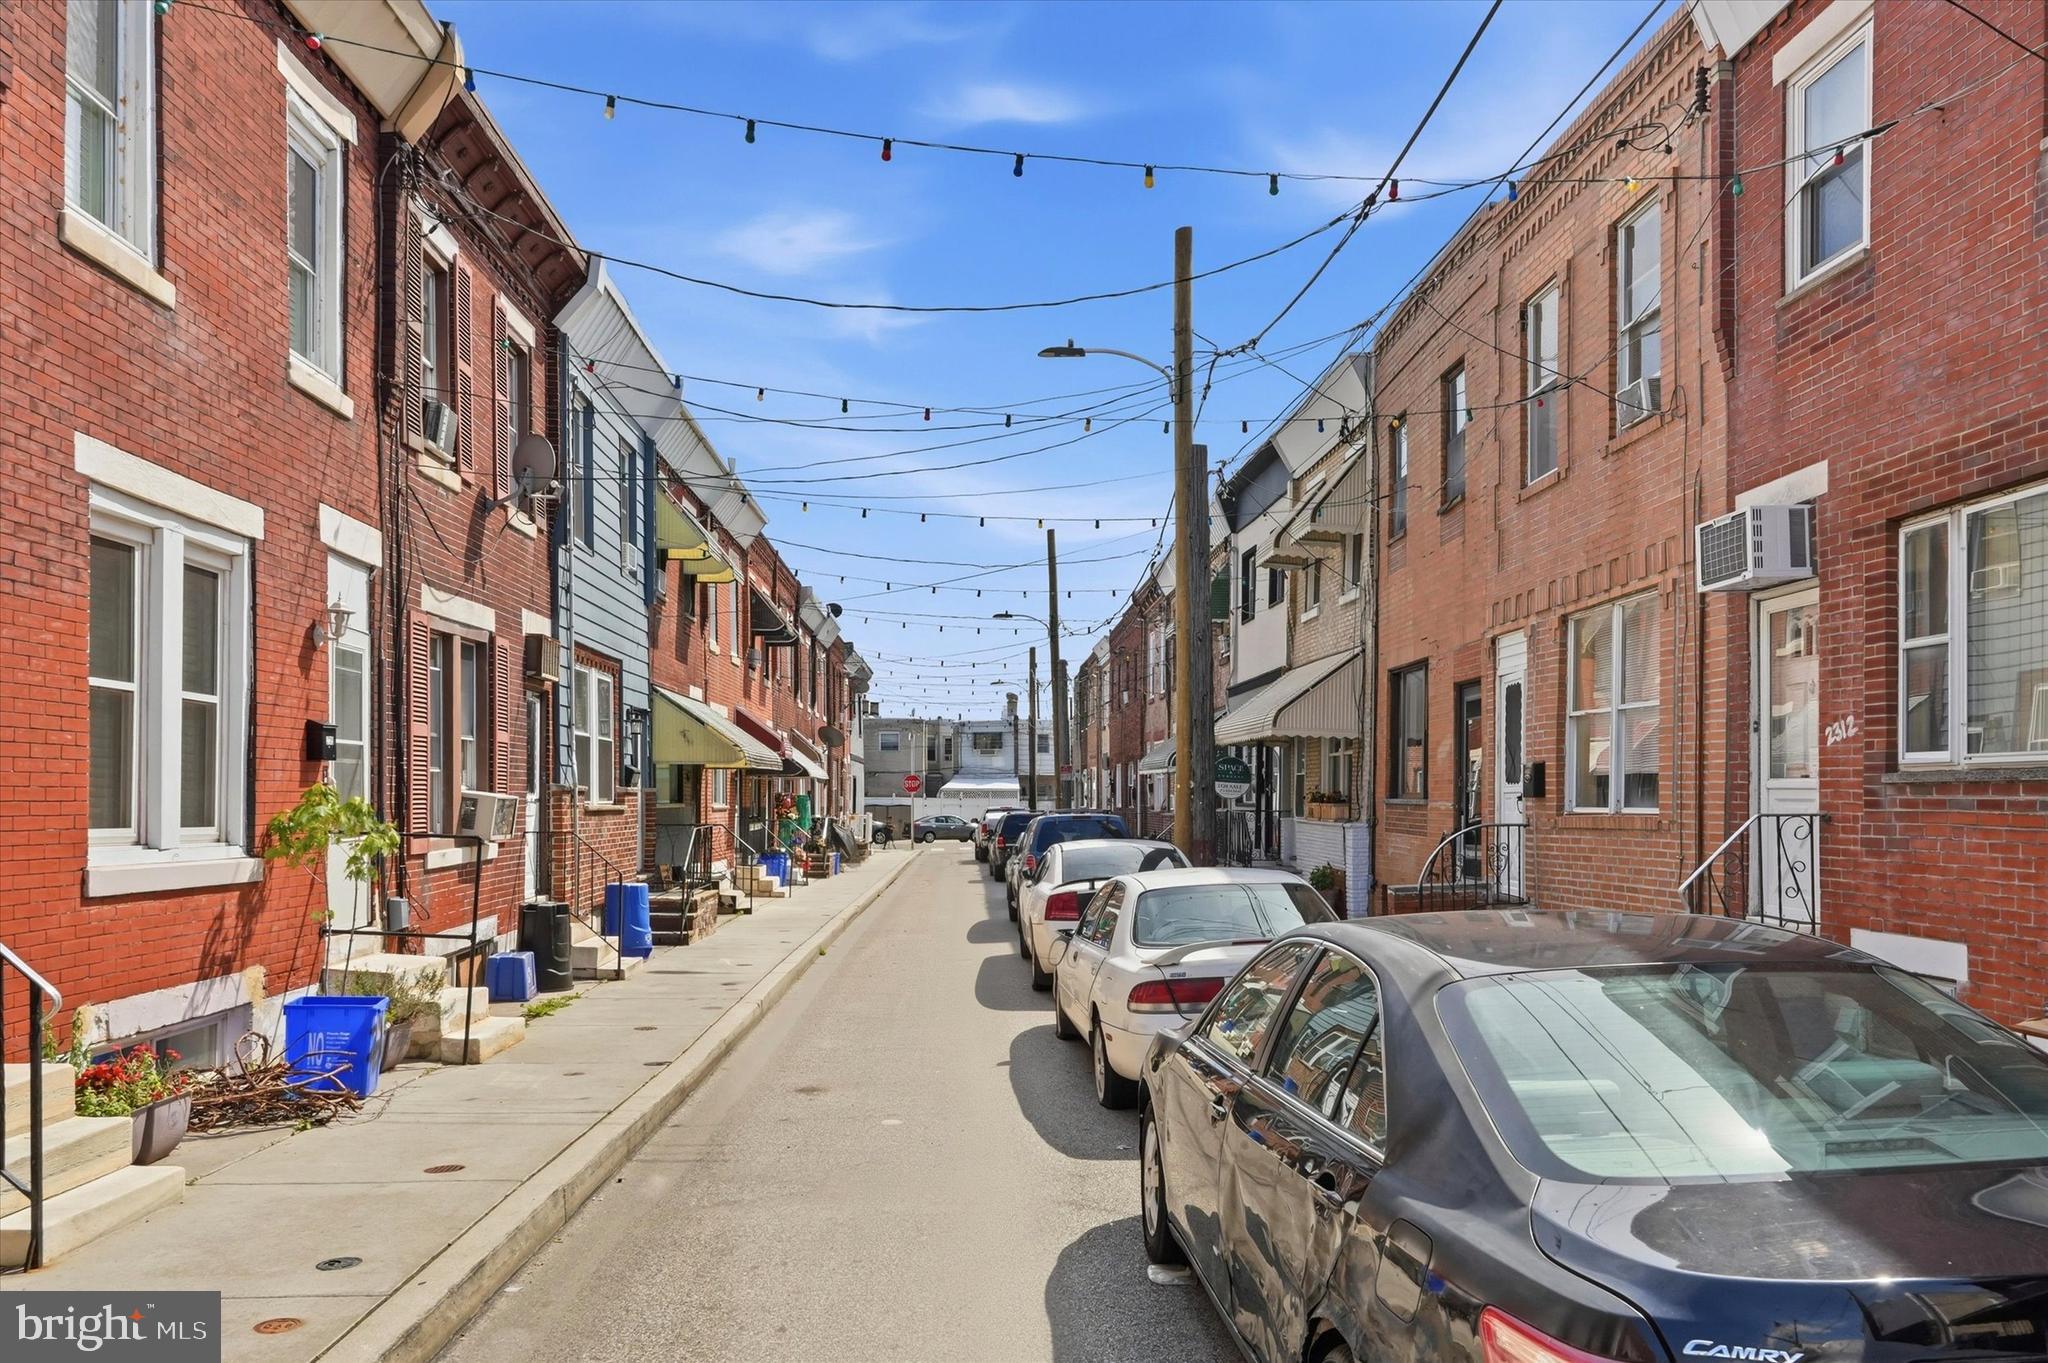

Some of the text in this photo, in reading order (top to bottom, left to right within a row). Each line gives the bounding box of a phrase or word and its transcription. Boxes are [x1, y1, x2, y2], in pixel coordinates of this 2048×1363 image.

[1825, 715, 1859, 747] 2312
[904, 780, 920, 788] STOP
[307, 1032, 325, 1066] NO
[1682, 1339, 1804, 1363] CAMRY
